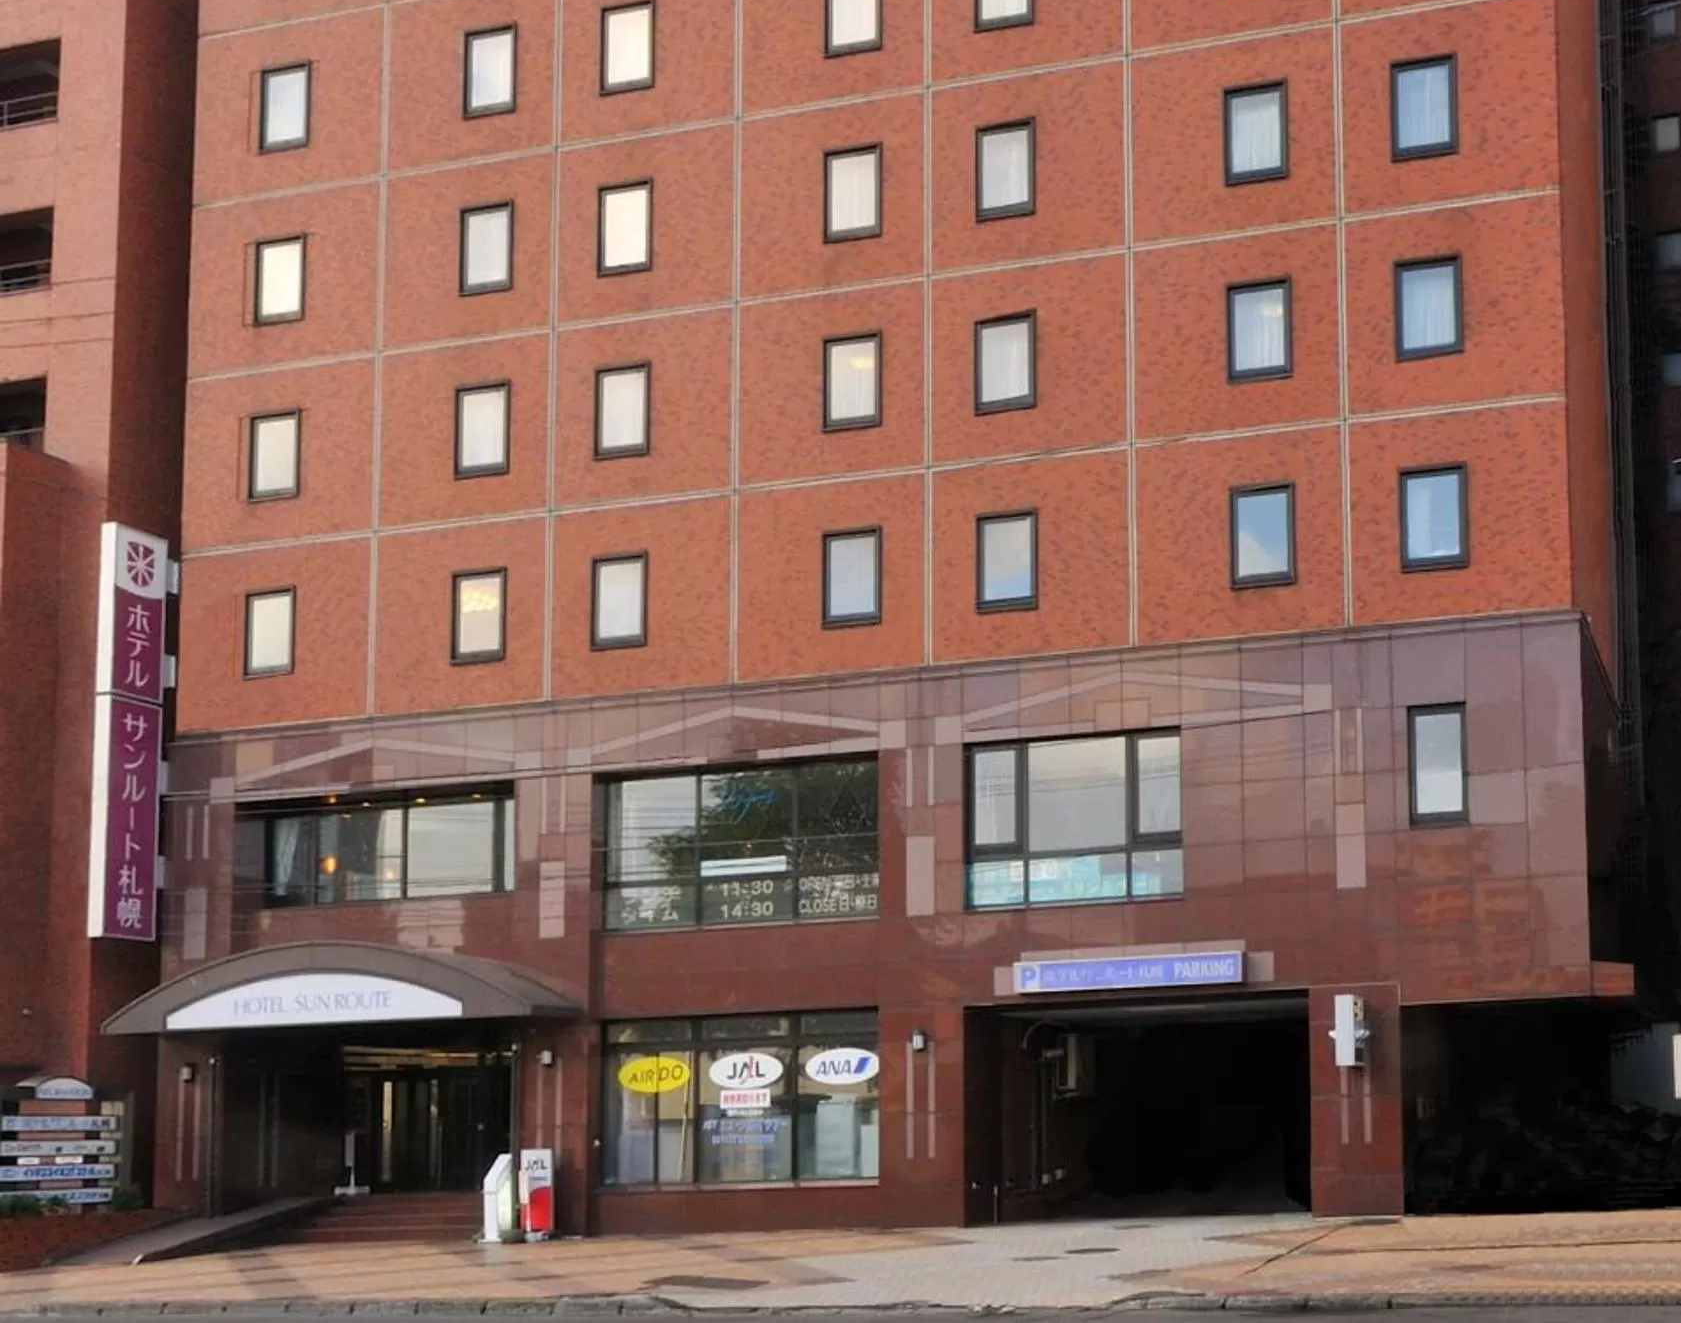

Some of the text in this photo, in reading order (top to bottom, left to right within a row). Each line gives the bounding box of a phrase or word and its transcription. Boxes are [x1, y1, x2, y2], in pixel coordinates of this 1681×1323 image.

[125, 602, 150, 689] ホテル
[116, 712, 149, 930] サンルート札幌
[720, 901, 775, 921] 14:30
[1173, 958, 1236, 979] PARKING
[233, 995, 285, 1017] HOTEL
[726, 1057, 766, 1084] JAL
[815, 1059, 853, 1077] ANA
